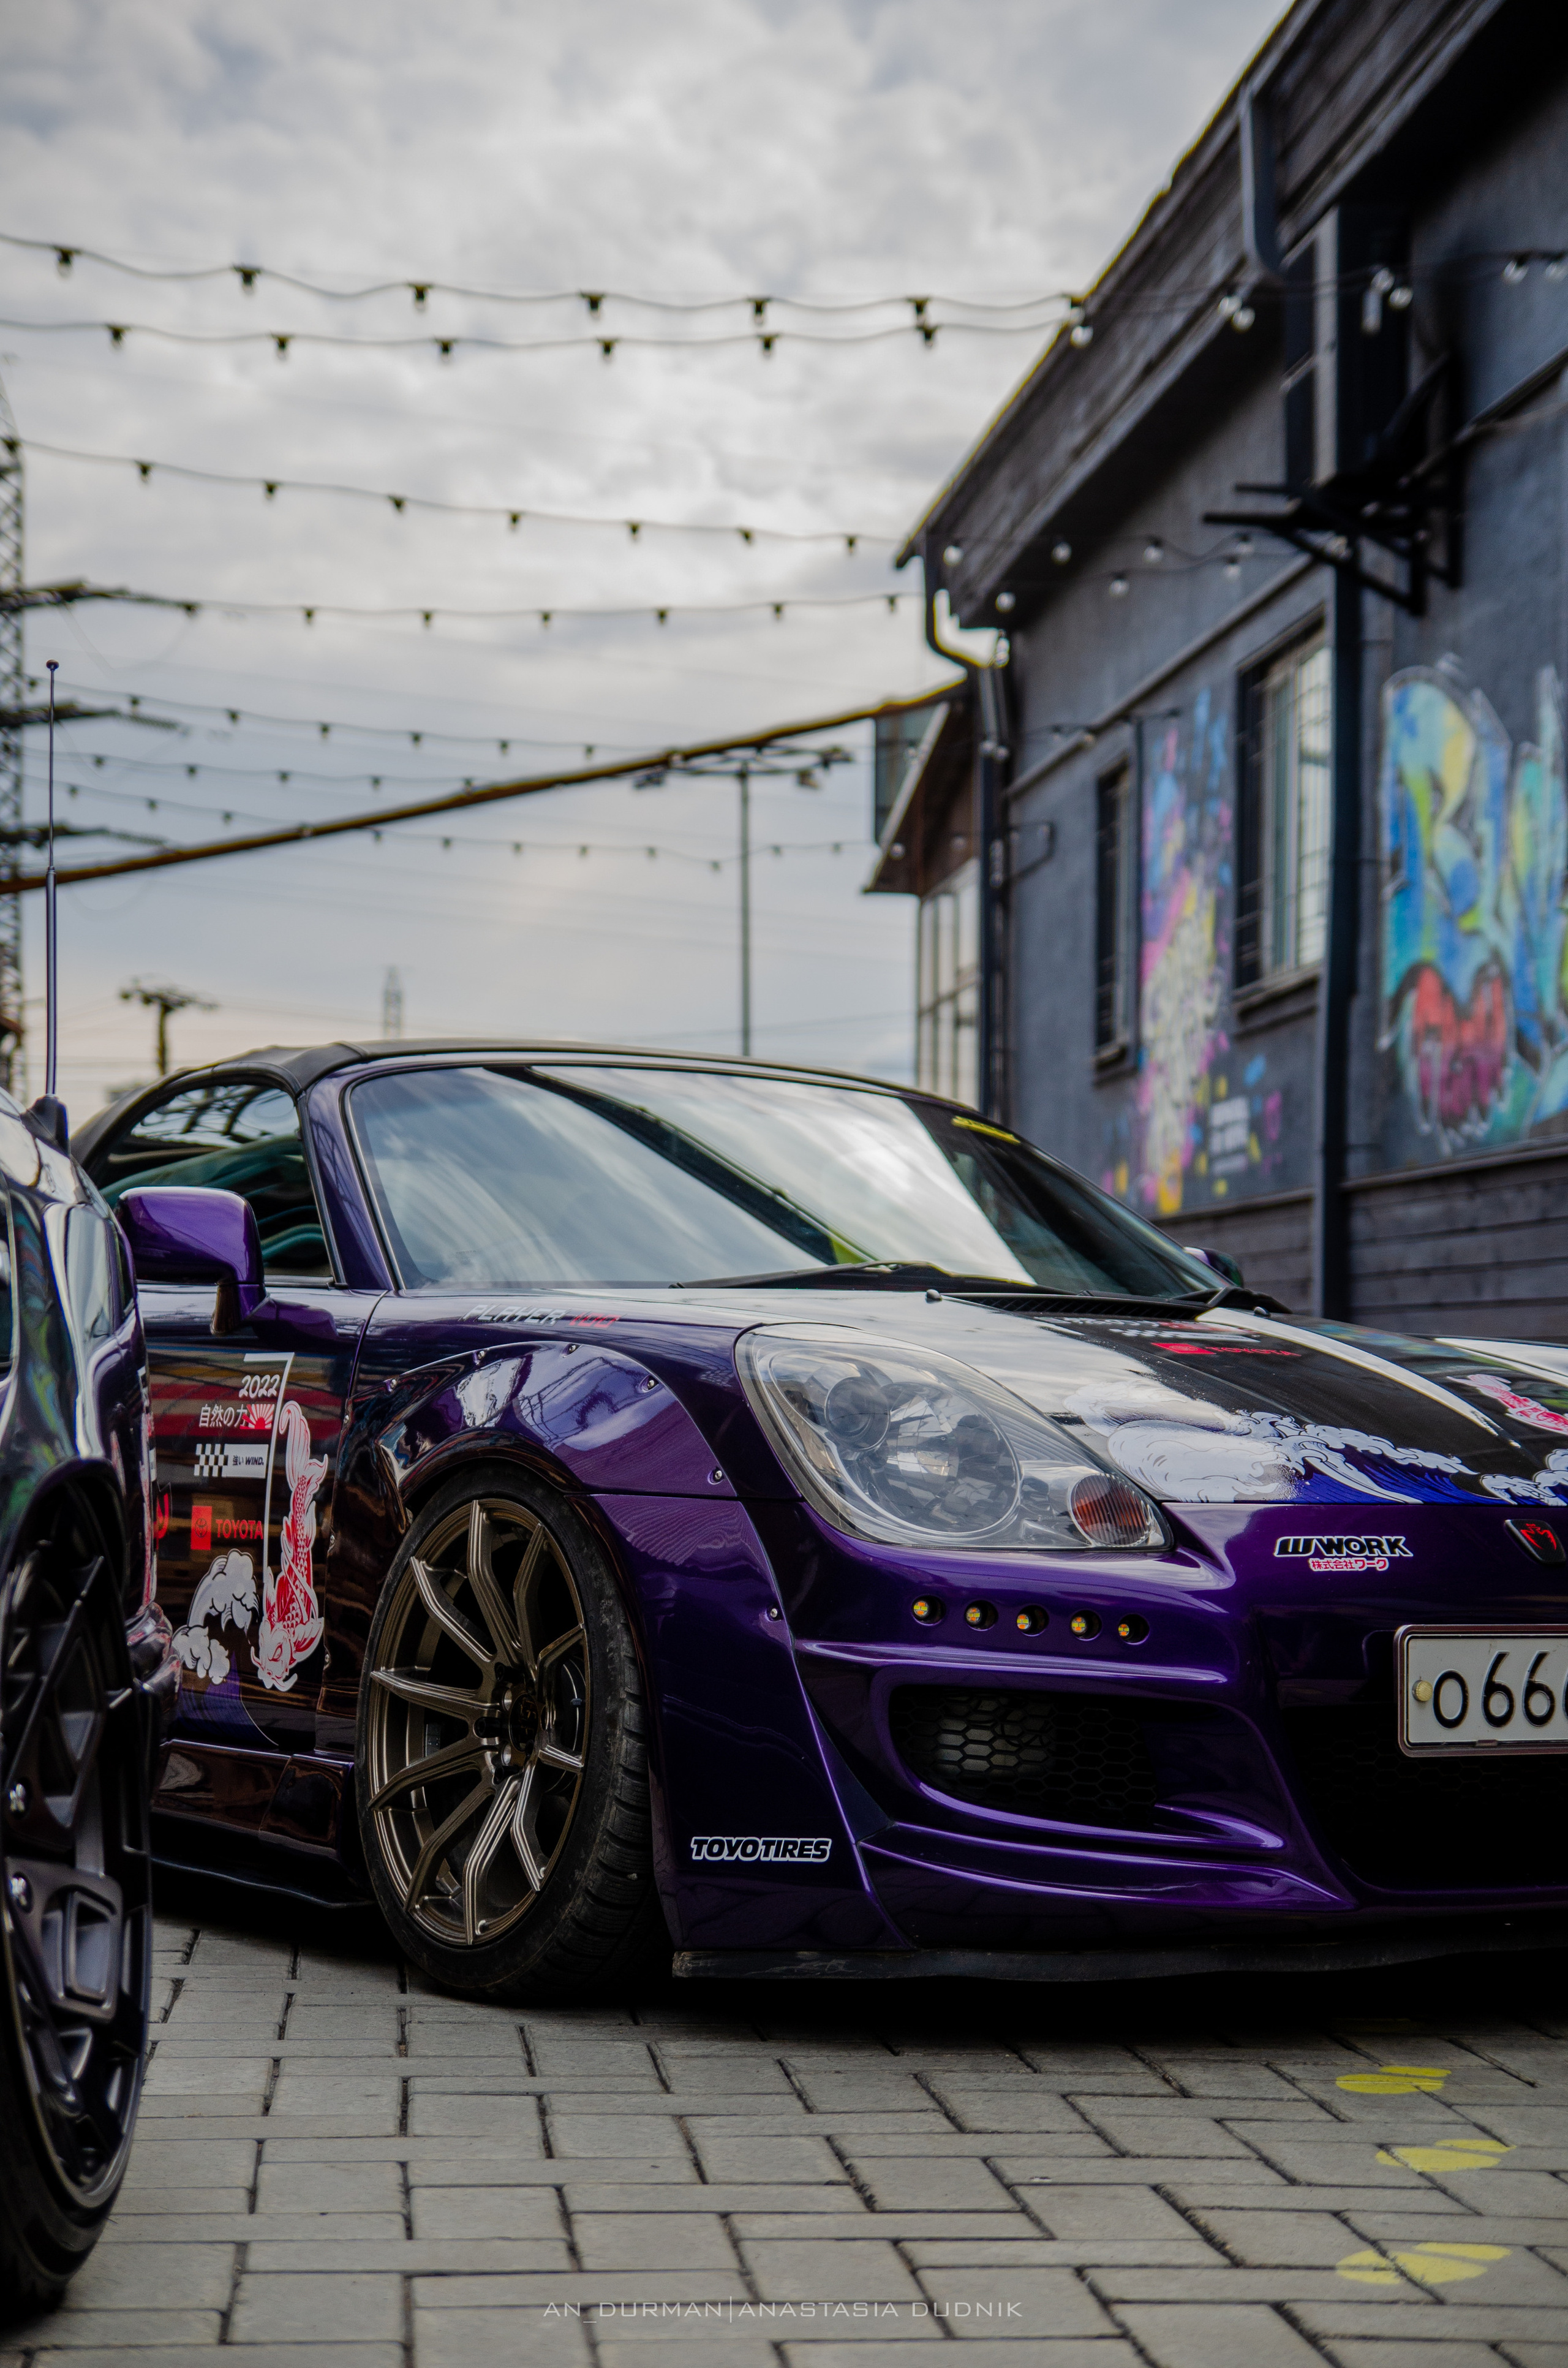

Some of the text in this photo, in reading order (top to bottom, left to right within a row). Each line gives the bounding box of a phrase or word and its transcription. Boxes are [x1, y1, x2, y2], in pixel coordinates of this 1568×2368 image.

[459, 1304, 570, 1325] PLAYER
[1205, 1346, 1302, 1356] TOYOTA
[239, 1374, 280, 1398] 2022
[216, 1519, 263, 1539] TOYOTA
[1310, 1558, 1389, 1571] 株式会社ワーク
